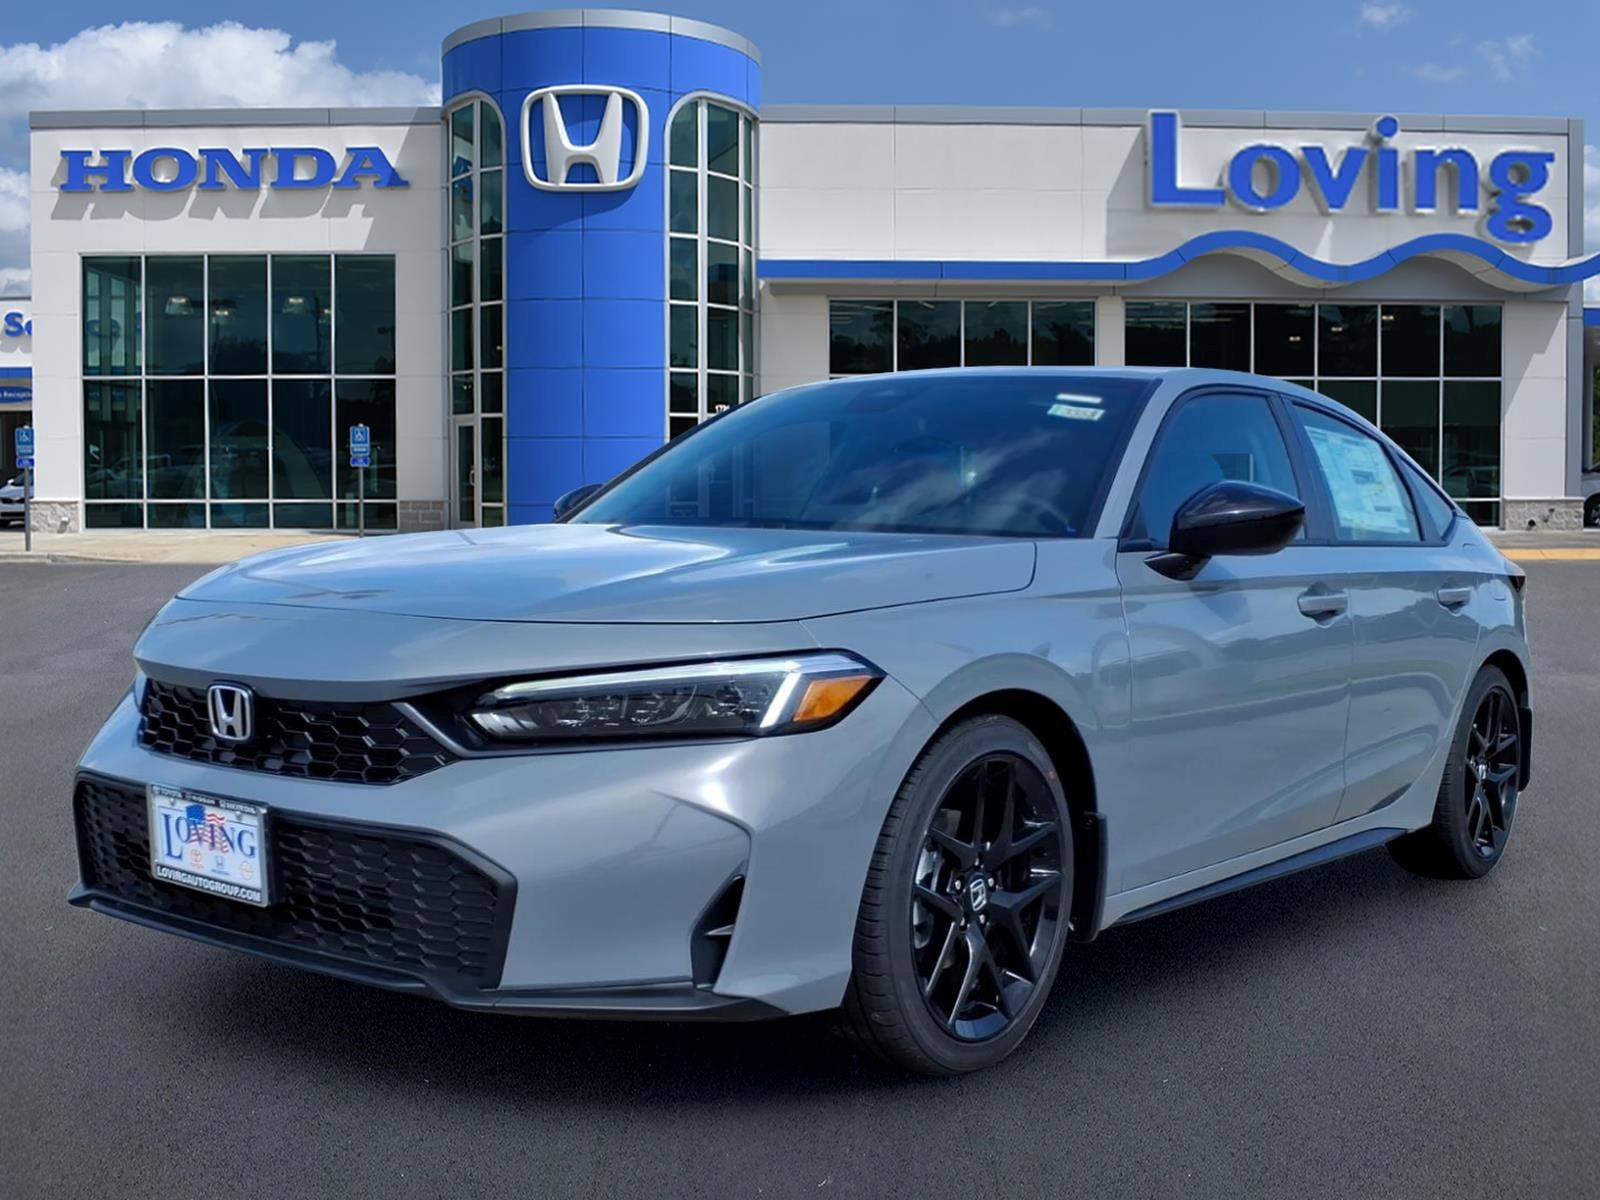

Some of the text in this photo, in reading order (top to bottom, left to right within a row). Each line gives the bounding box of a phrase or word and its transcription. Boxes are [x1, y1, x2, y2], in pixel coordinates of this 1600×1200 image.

[60, 146, 410, 192] HONDA
[1148, 110, 1556, 244] Loving
[163, 814, 256, 859] LOVING
[157, 867, 261, 902] LOVINGAUTOGROUP.COM
